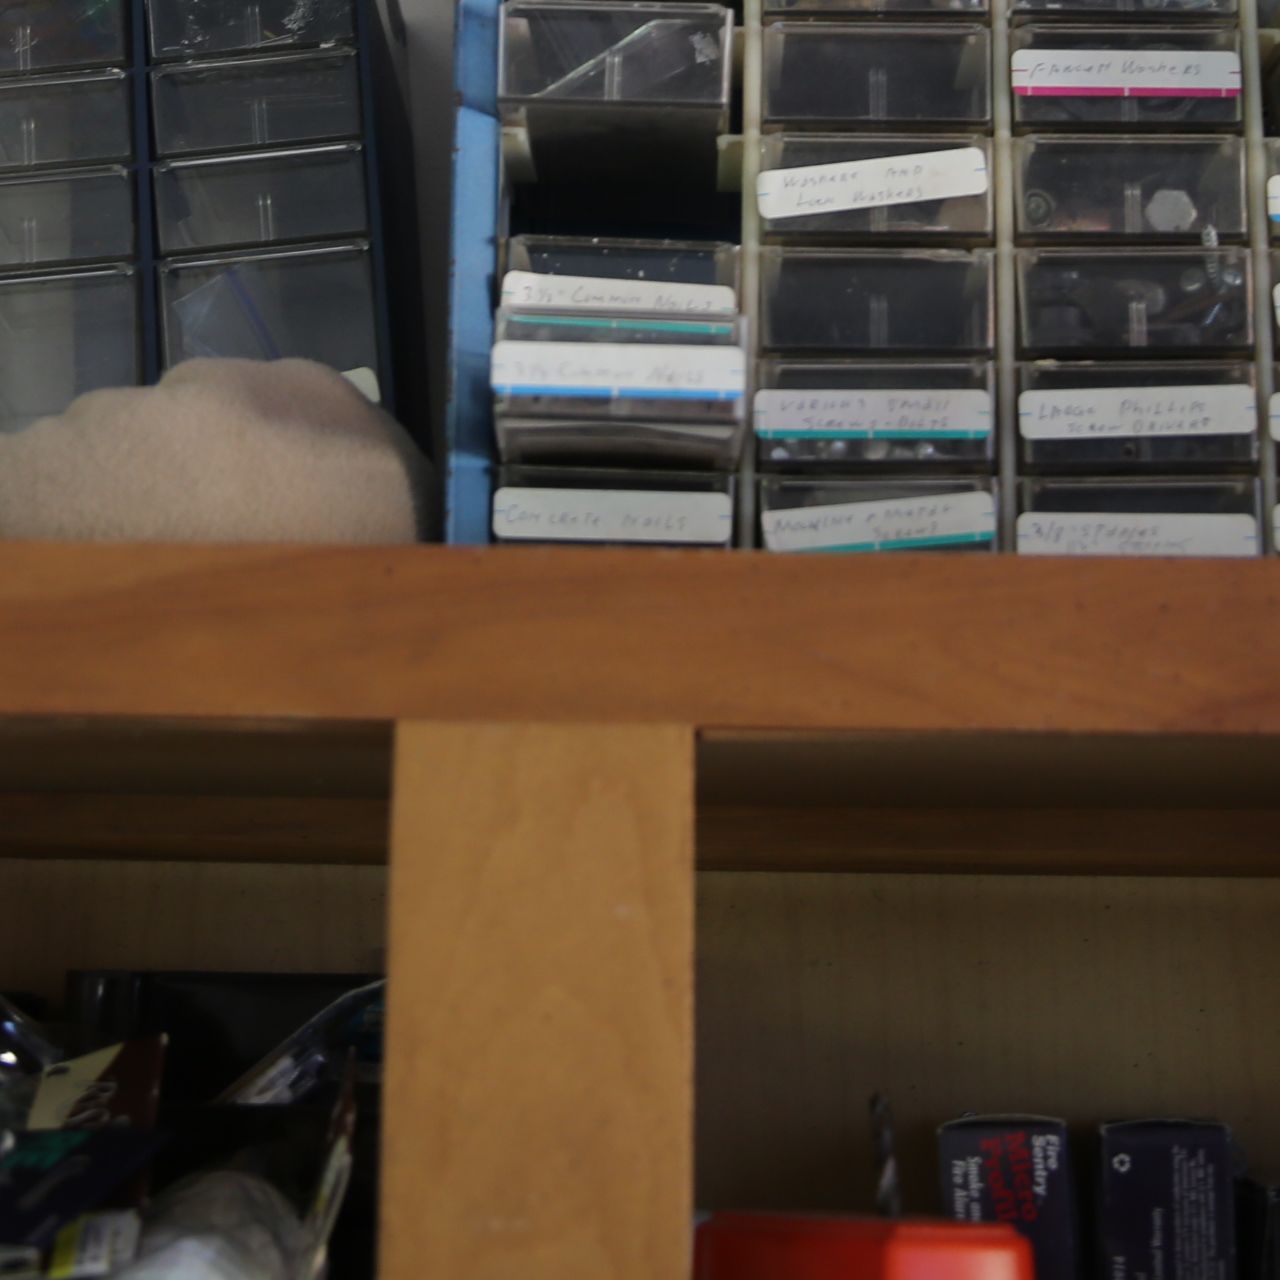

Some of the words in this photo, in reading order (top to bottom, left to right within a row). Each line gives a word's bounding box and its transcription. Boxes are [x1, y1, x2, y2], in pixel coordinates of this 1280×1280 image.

[1031, 1133, 1049, 1197] Sentry
[1045, 1133, 1061, 1171] Fire
[966, 1155, 983, 1198] Smoke
